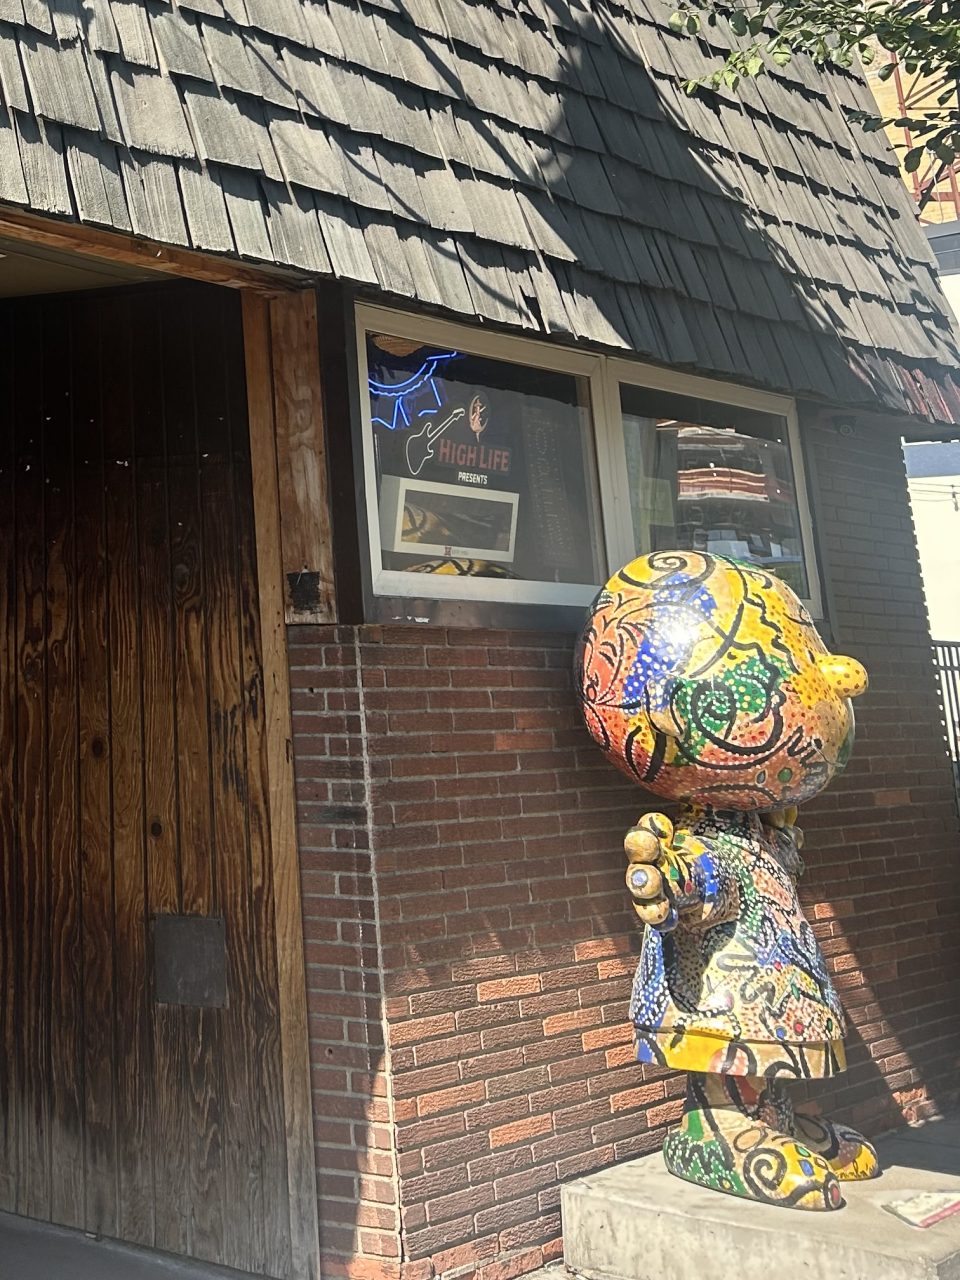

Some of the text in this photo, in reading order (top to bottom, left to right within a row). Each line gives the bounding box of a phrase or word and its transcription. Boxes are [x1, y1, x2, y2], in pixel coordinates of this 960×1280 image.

[438, 438, 511, 472] HIGH LIFE
[457, 471, 489, 485] PRESENTS
